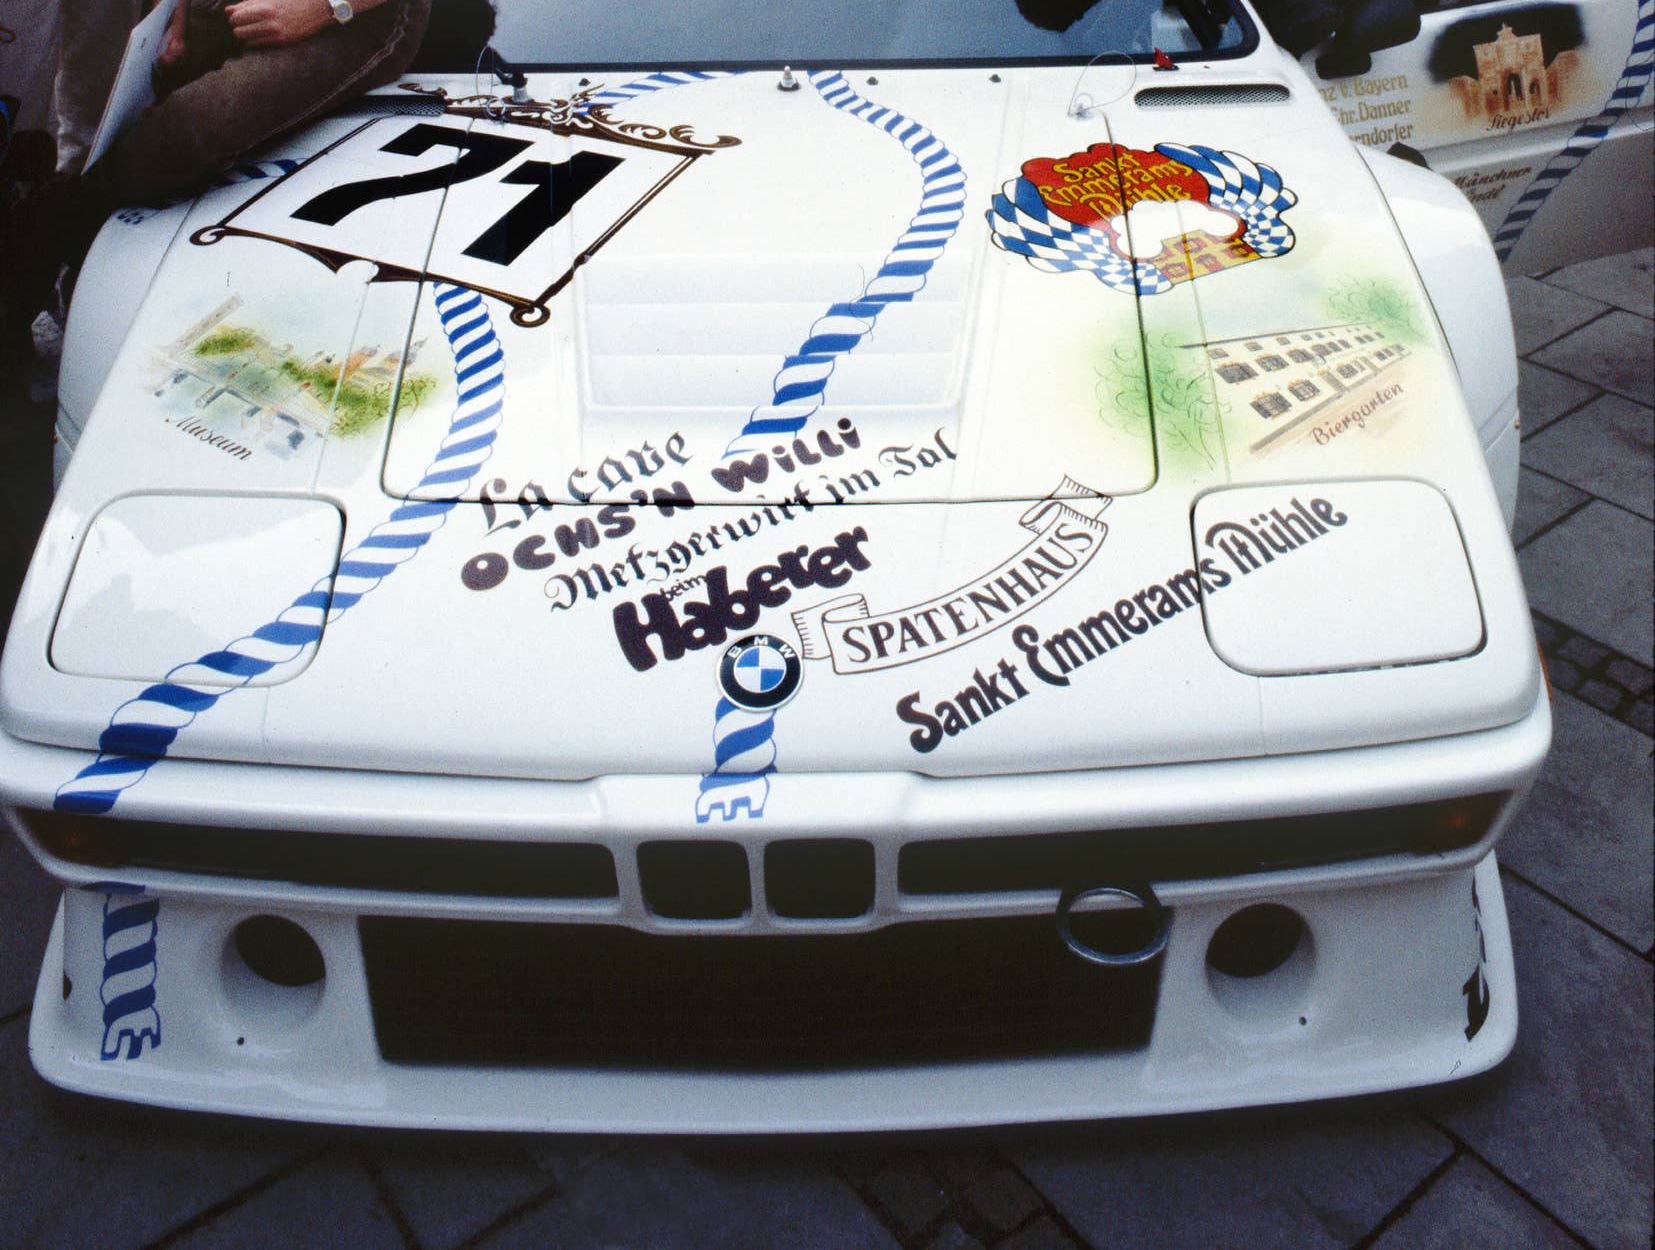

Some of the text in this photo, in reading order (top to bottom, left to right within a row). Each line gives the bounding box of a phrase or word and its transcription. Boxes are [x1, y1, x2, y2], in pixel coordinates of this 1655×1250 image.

[290, 123, 627, 267] 21
[1053, 153, 1141, 183] Sankt
[165, 415, 252, 460] Museum
[1309, 381, 1404, 446] Biergarten
[818, 474, 880, 504] im
[612, 526, 872, 672] Haberer
[842, 521, 1094, 664] SPATENHAUS
[727, 636, 794, 659] BMW
[896, 497, 1348, 754] Sankt Emmerams Mühle
